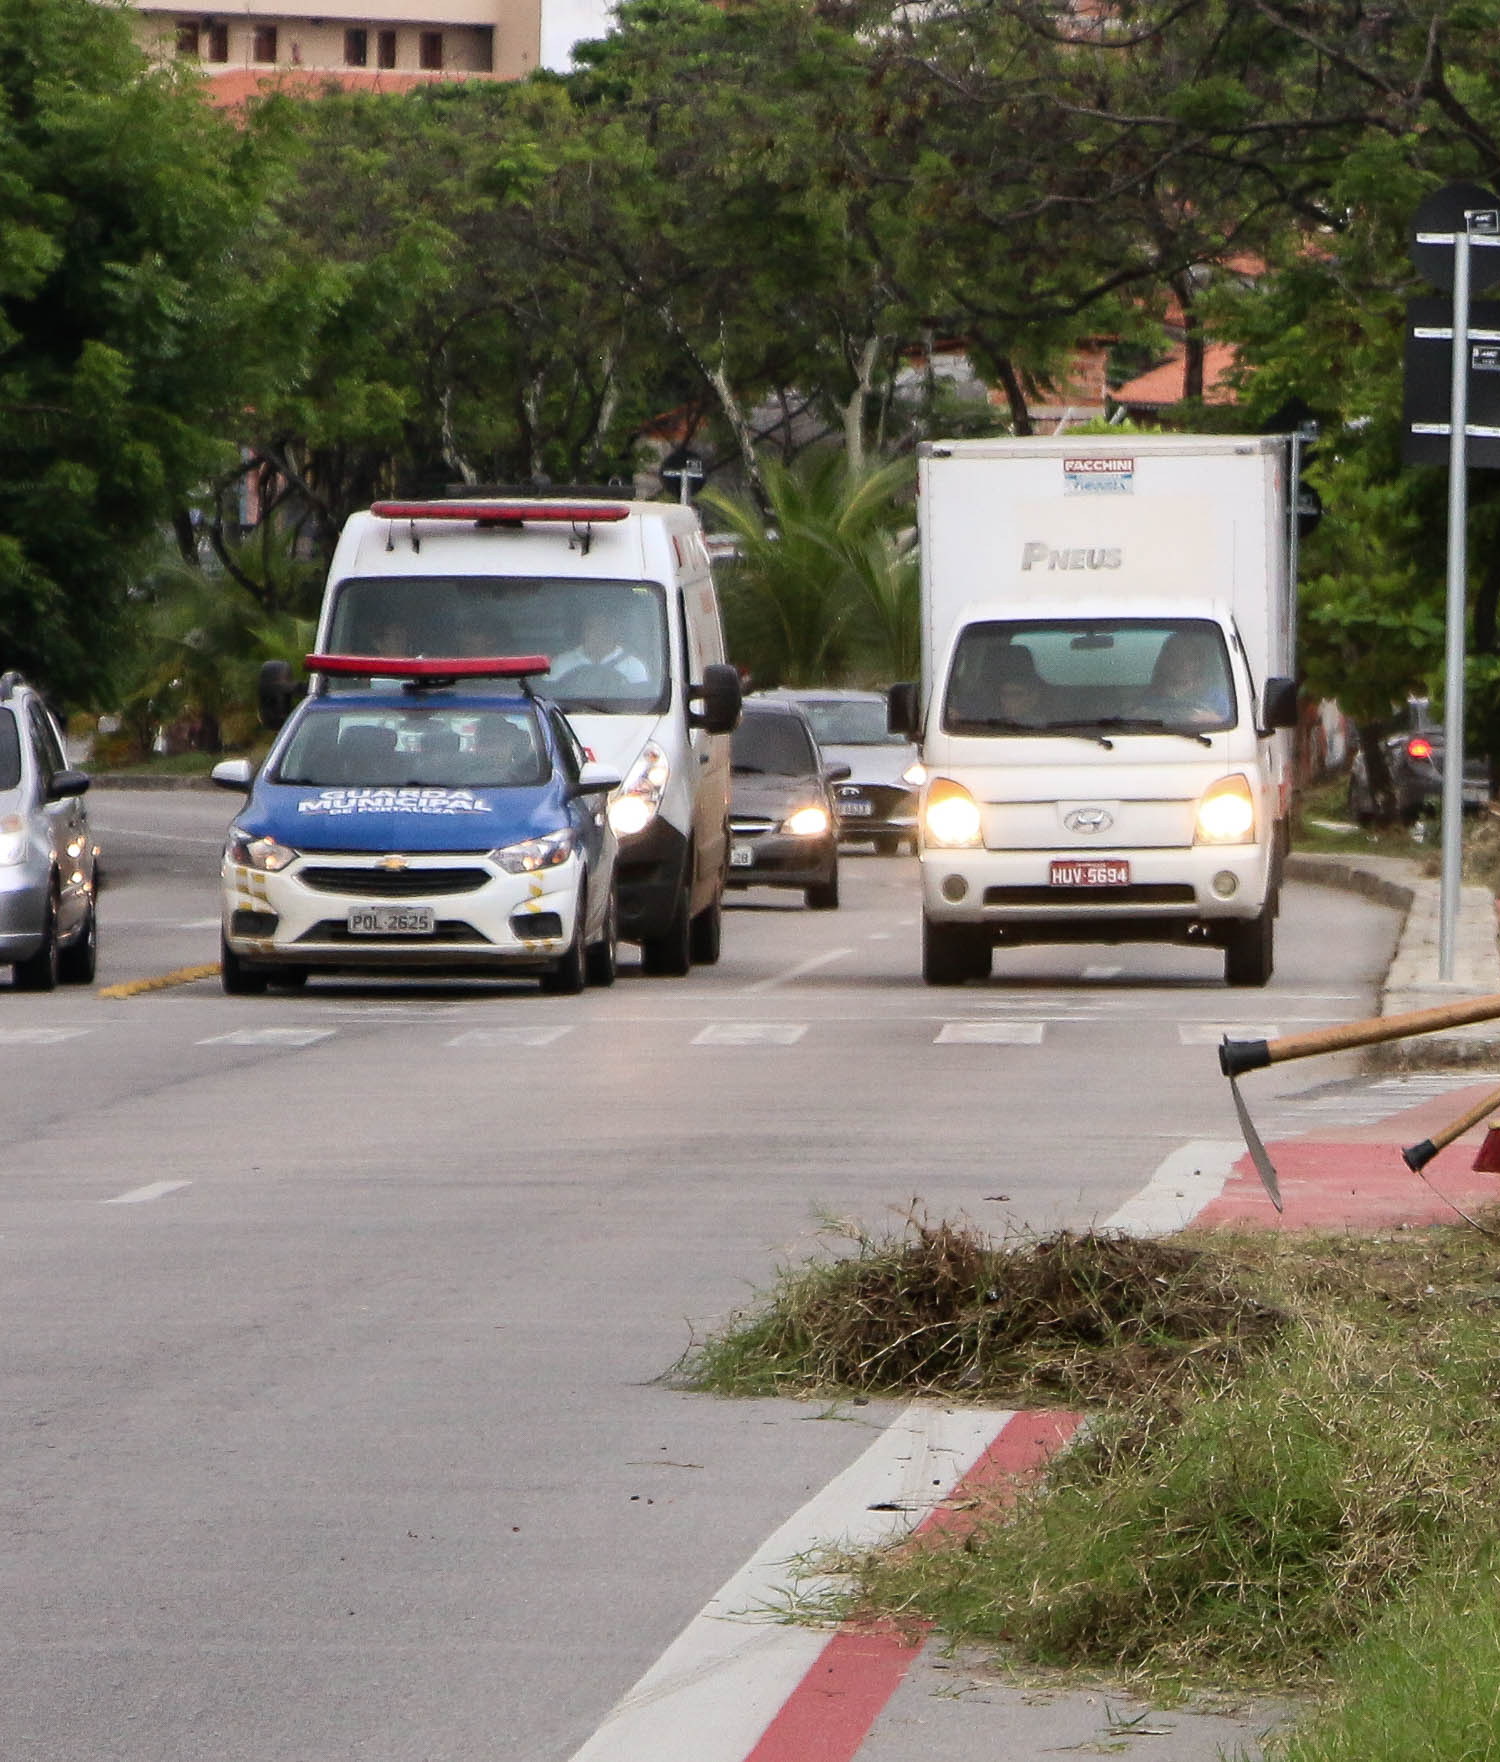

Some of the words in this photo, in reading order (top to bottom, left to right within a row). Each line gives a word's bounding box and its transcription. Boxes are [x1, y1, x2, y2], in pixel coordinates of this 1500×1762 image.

[1065, 460, 1132, 471] FACCHINI
[1022, 542, 1122, 570] PNEUS
[319, 788, 474, 800] GUARDA
[298, 798, 493, 812] MUNICIPAL
